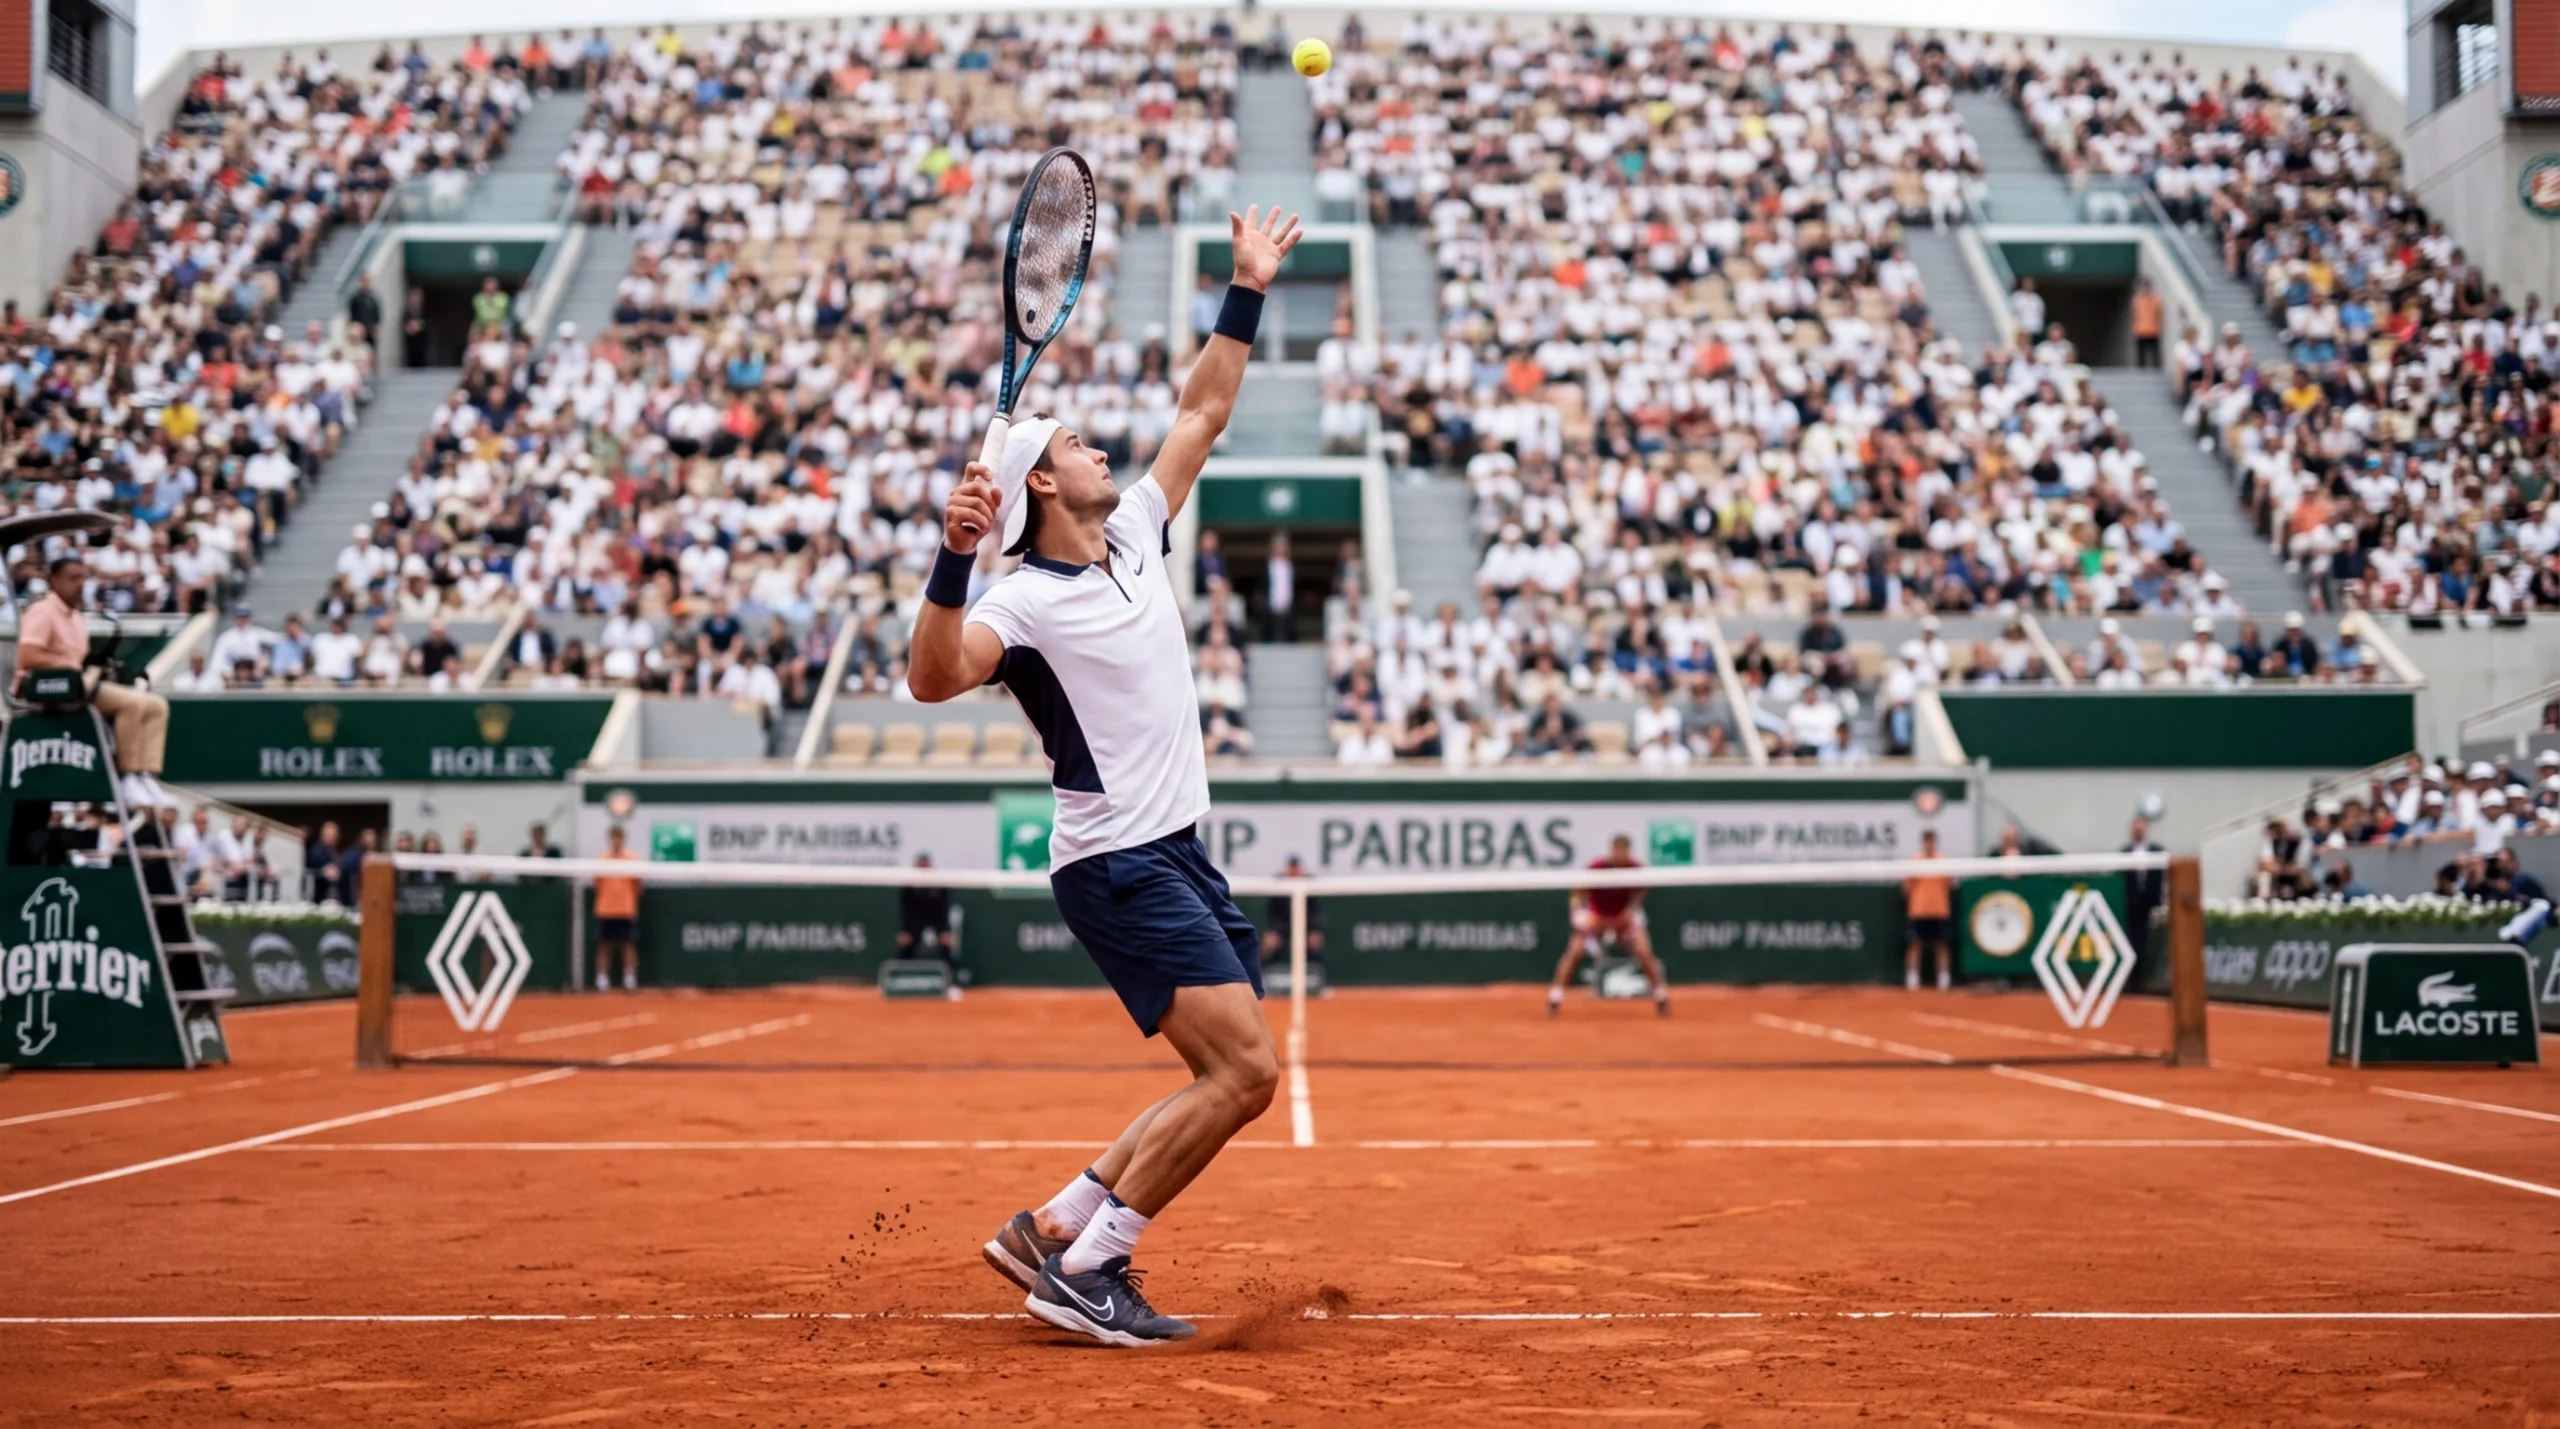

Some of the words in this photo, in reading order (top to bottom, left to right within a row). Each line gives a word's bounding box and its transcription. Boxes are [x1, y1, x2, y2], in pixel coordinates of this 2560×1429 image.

[260, 747, 383, 777] ROLEX
[431, 746, 554, 776] ROLEX
[709, 824, 768, 849] BNP
[776, 824, 902, 849] PARIBAS
[1321, 818, 1575, 868] PARIBAS
[1706, 823, 1768, 849] BNP
[1774, 823, 1898, 849] PARIBAS
[682, 921, 743, 951] BNP
[746, 921, 866, 951] PARIBAS
[1353, 921, 1414, 950] BNP
[1417, 921, 1538, 950] PARIBAS
[1681, 921, 1742, 950] BNP
[1745, 921, 1864, 950] PARIBAS
[2376, 1010, 2519, 1036] LACOSTE
